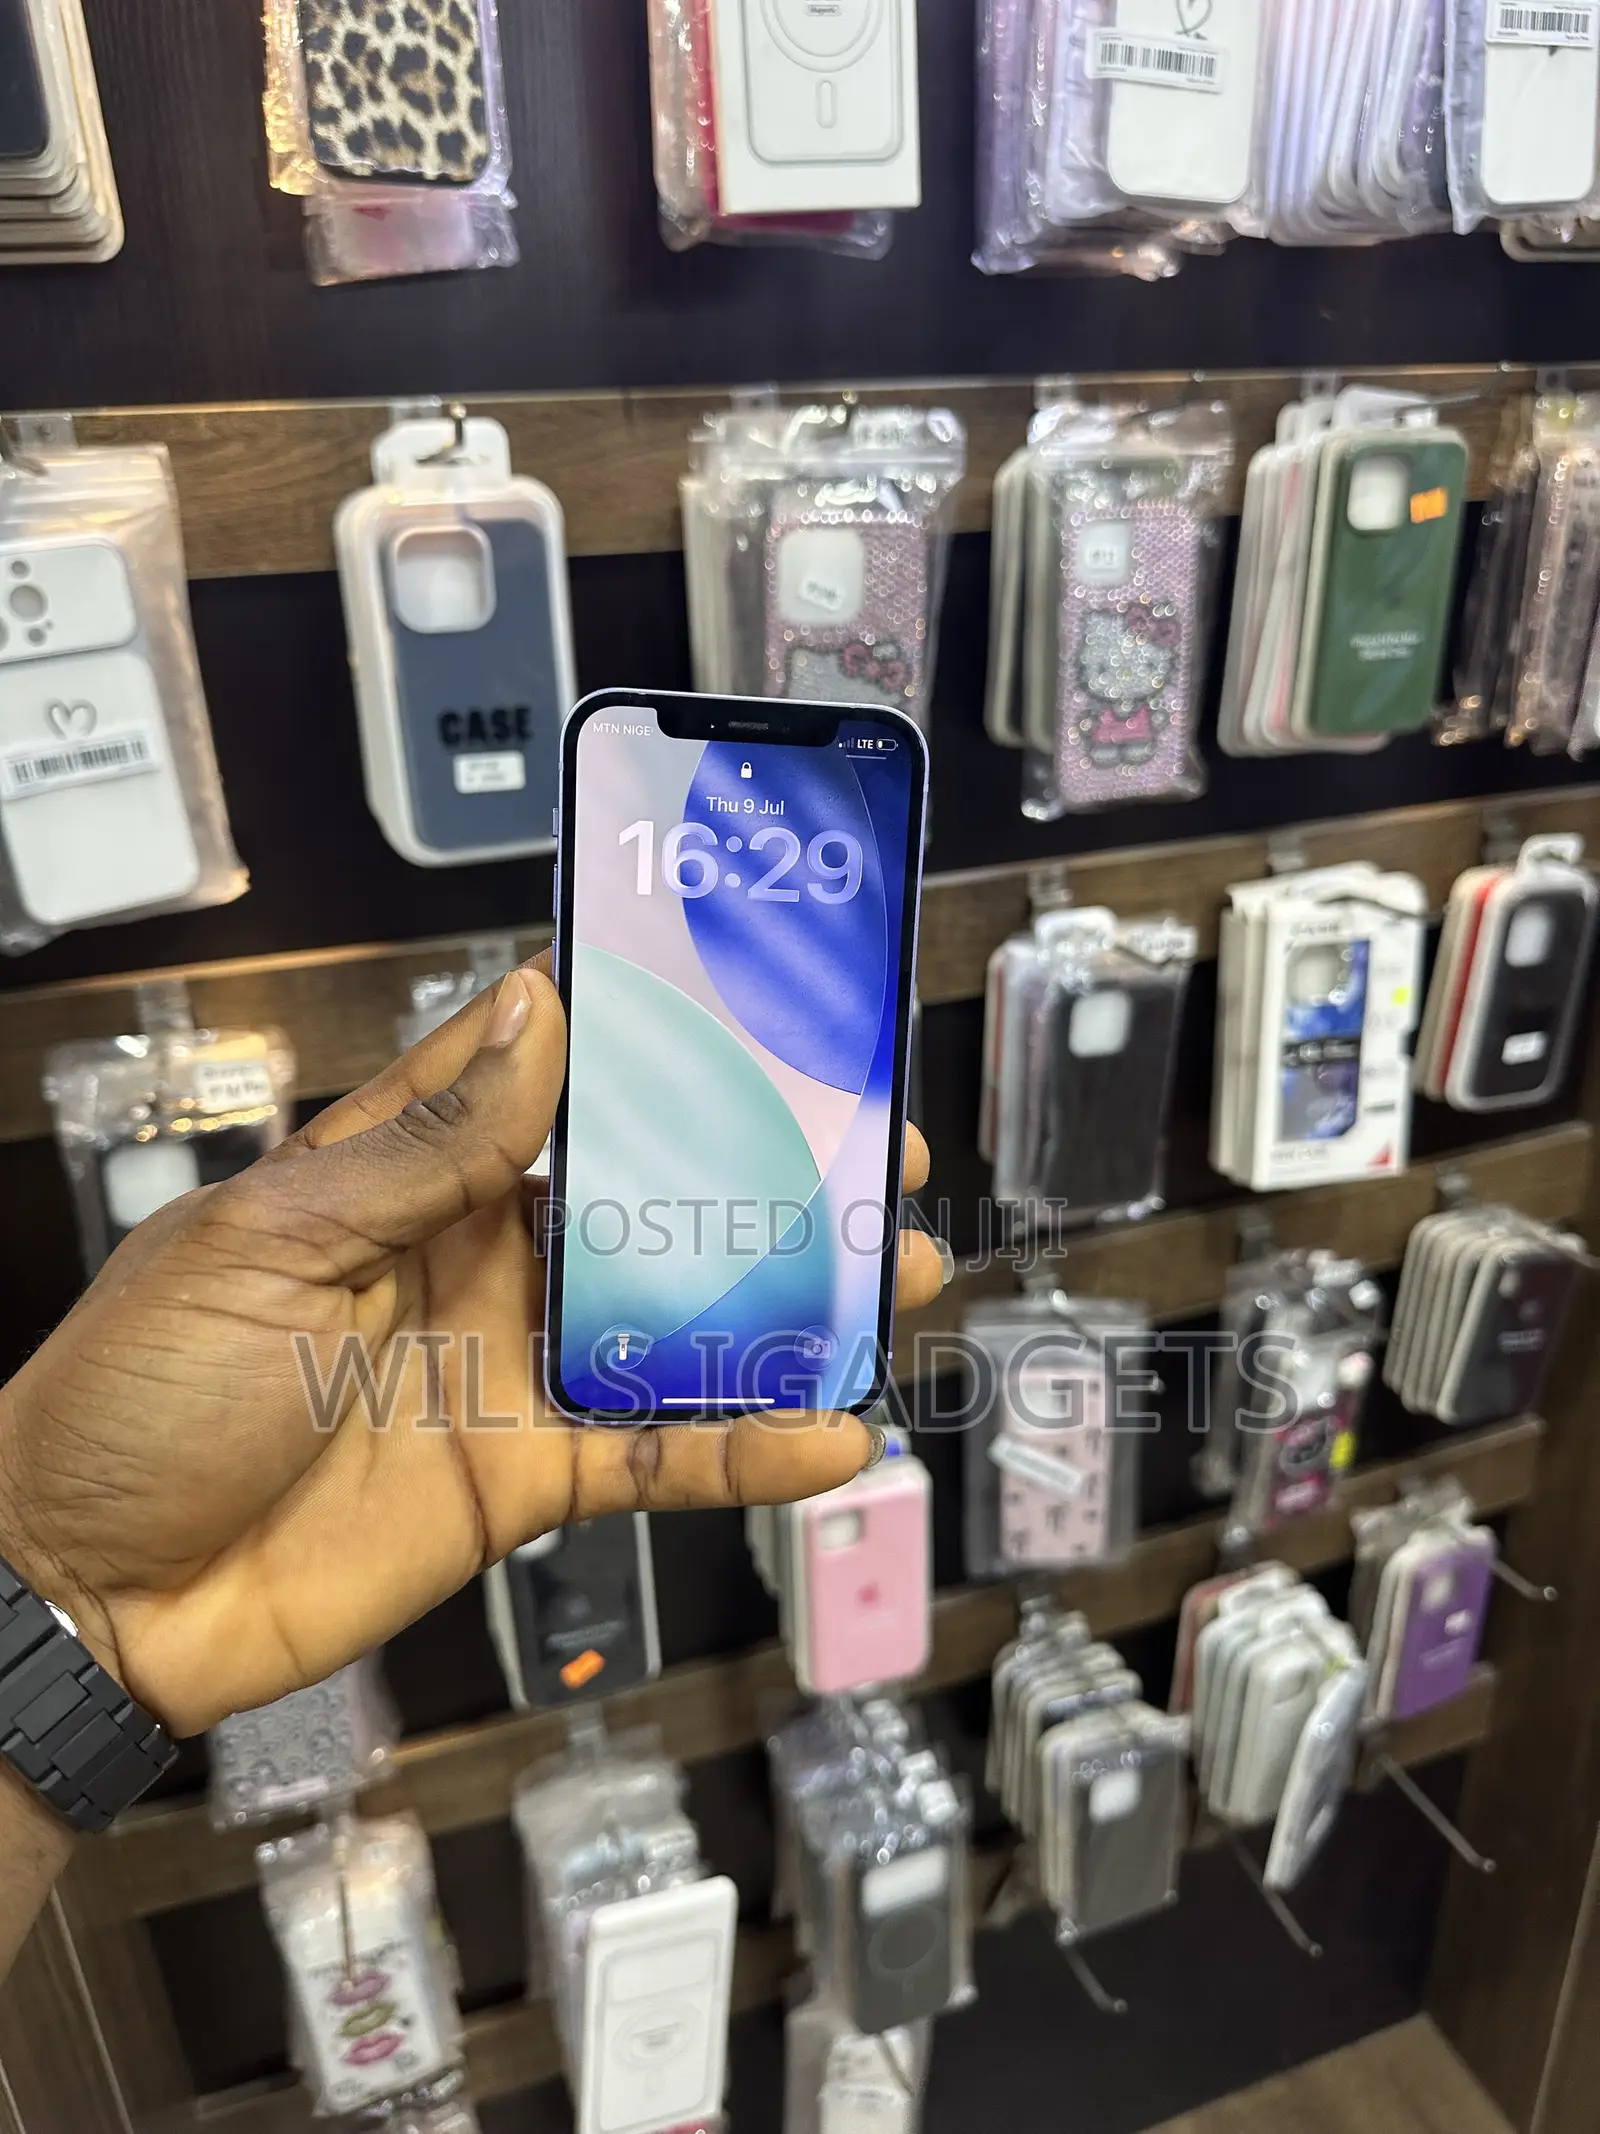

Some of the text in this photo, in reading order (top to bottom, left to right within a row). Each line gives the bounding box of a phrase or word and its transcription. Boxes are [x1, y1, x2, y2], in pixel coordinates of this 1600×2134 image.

[437, 704, 534, 744] CASE
[593, 722, 652, 736] MTN NIGE
[857, 739, 874, 749] LTE
[705, 796, 784, 816] Thu 9 Jul
[618, 820, 863, 905] 16:29
